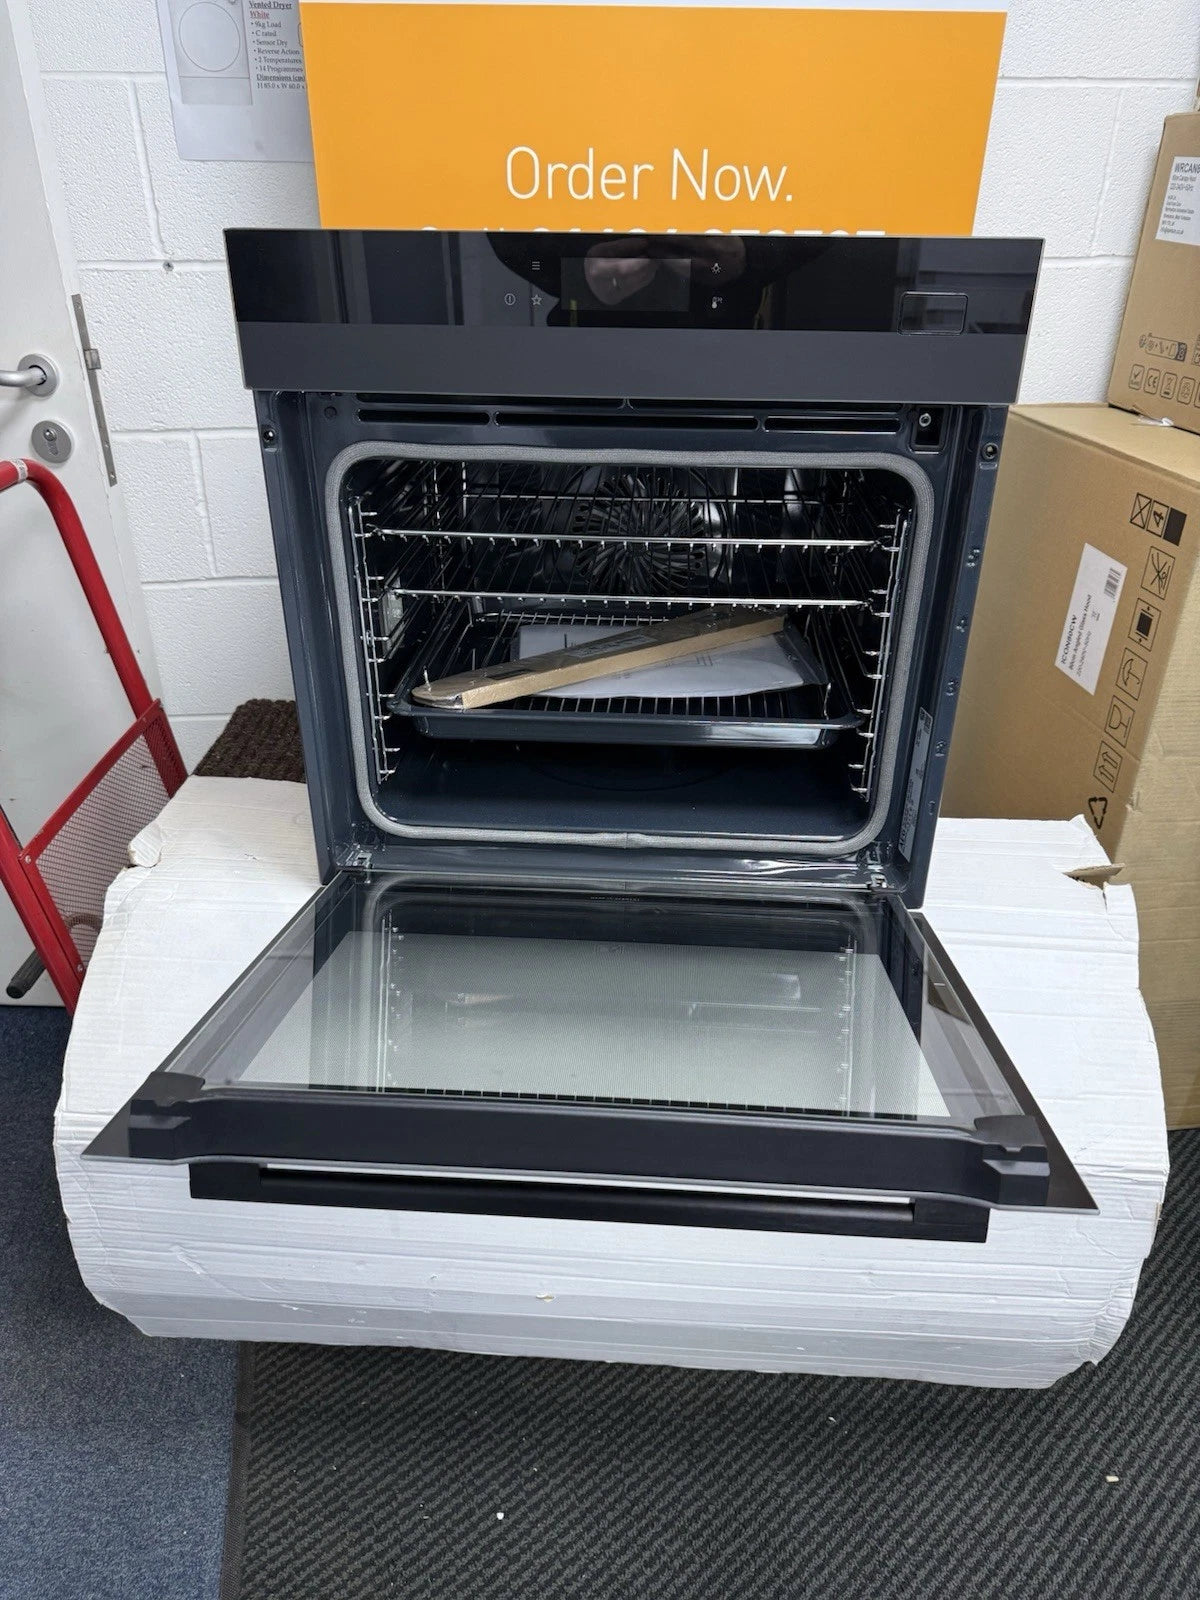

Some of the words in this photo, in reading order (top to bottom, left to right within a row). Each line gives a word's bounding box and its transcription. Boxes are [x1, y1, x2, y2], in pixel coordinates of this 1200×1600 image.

[273, 1, 292, 10] Dryer
[250, 10, 269, 19] White
[277, 40, 288, 48] Dry
[263, 56, 303, 64] Temperatures
[267, 65, 304, 73] Programmes
[257, 73, 292, 81] Dimensions
[506, 146, 653, 200] Order
[671, 148, 793, 201] Now.
